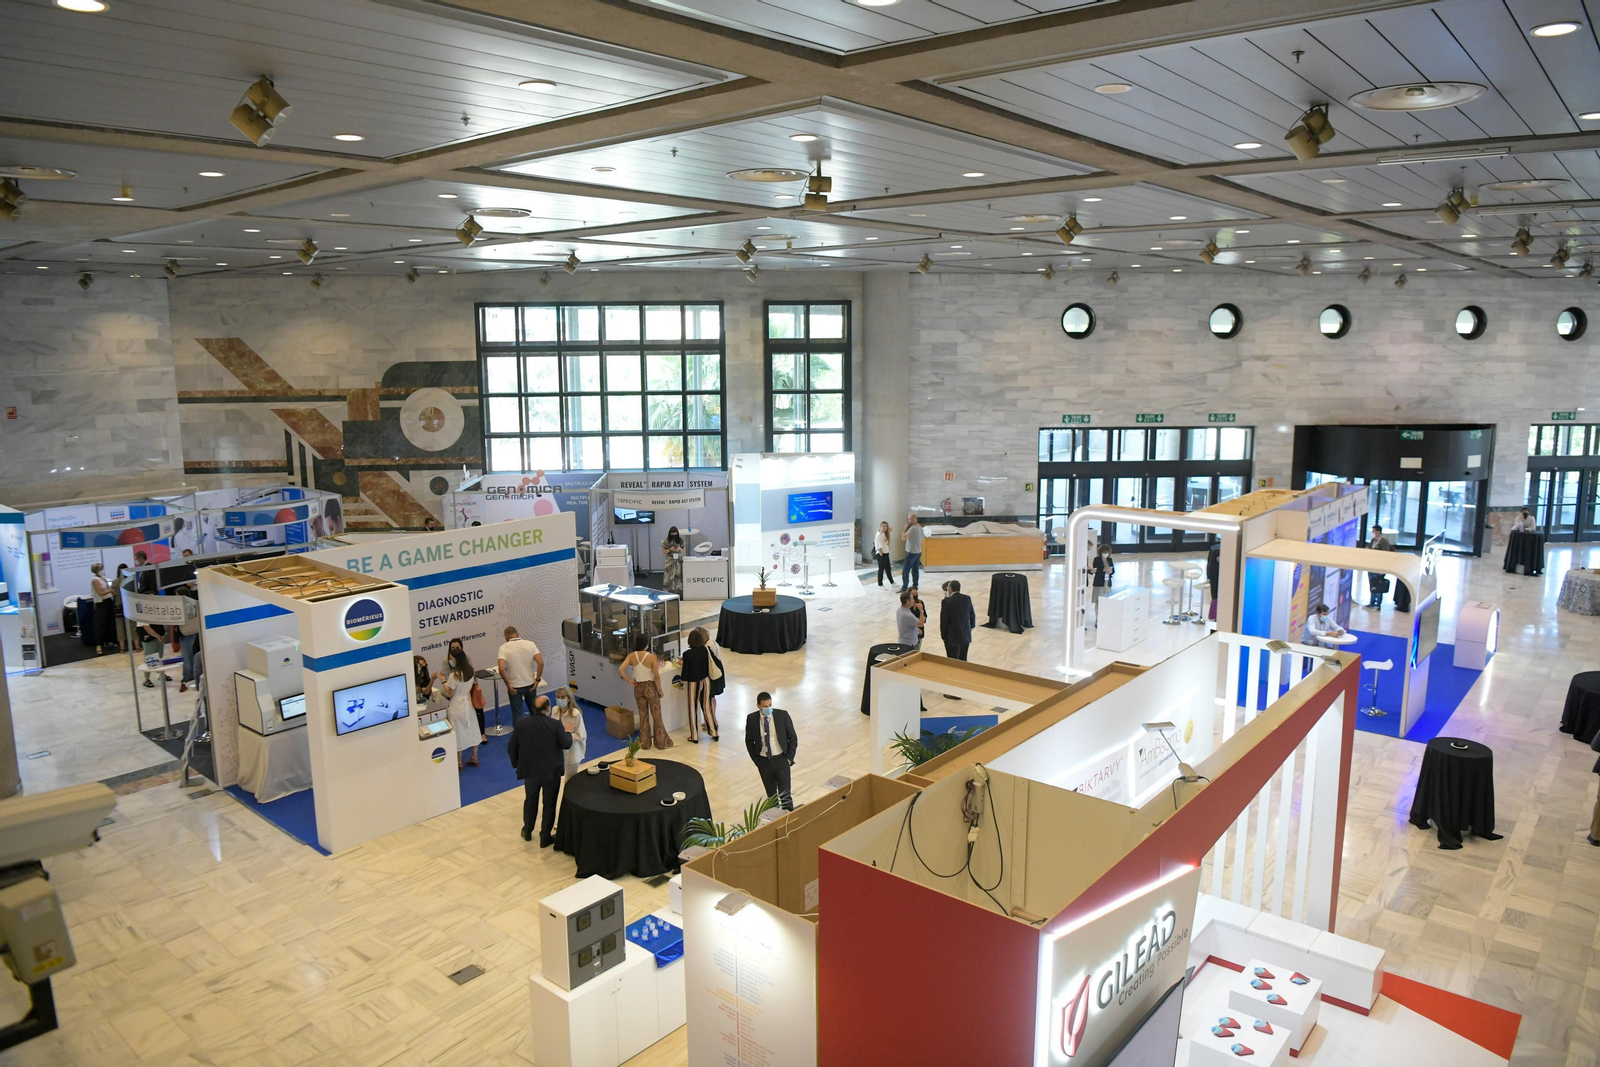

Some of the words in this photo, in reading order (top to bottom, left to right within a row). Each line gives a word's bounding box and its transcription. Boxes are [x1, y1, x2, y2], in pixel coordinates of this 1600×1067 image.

[346, 556, 374, 575] BE
[379, 553, 393, 571] A
[397, 543, 454, 567] GAME
[458, 528, 543, 557] CHANGER
[144, 604, 182, 616] deltalab
[417, 589, 484, 612] DIAGNOSTIC
[346, 612, 383, 625] BIOMÉRIEUX
[418, 603, 495, 629] STEWARDSHIP
[421, 642, 443, 652] makes
[1096, 910, 1176, 1010] GILEAD
[1118, 964, 1155, 1006] Creating
[1157, 927, 1189, 967] Possible
